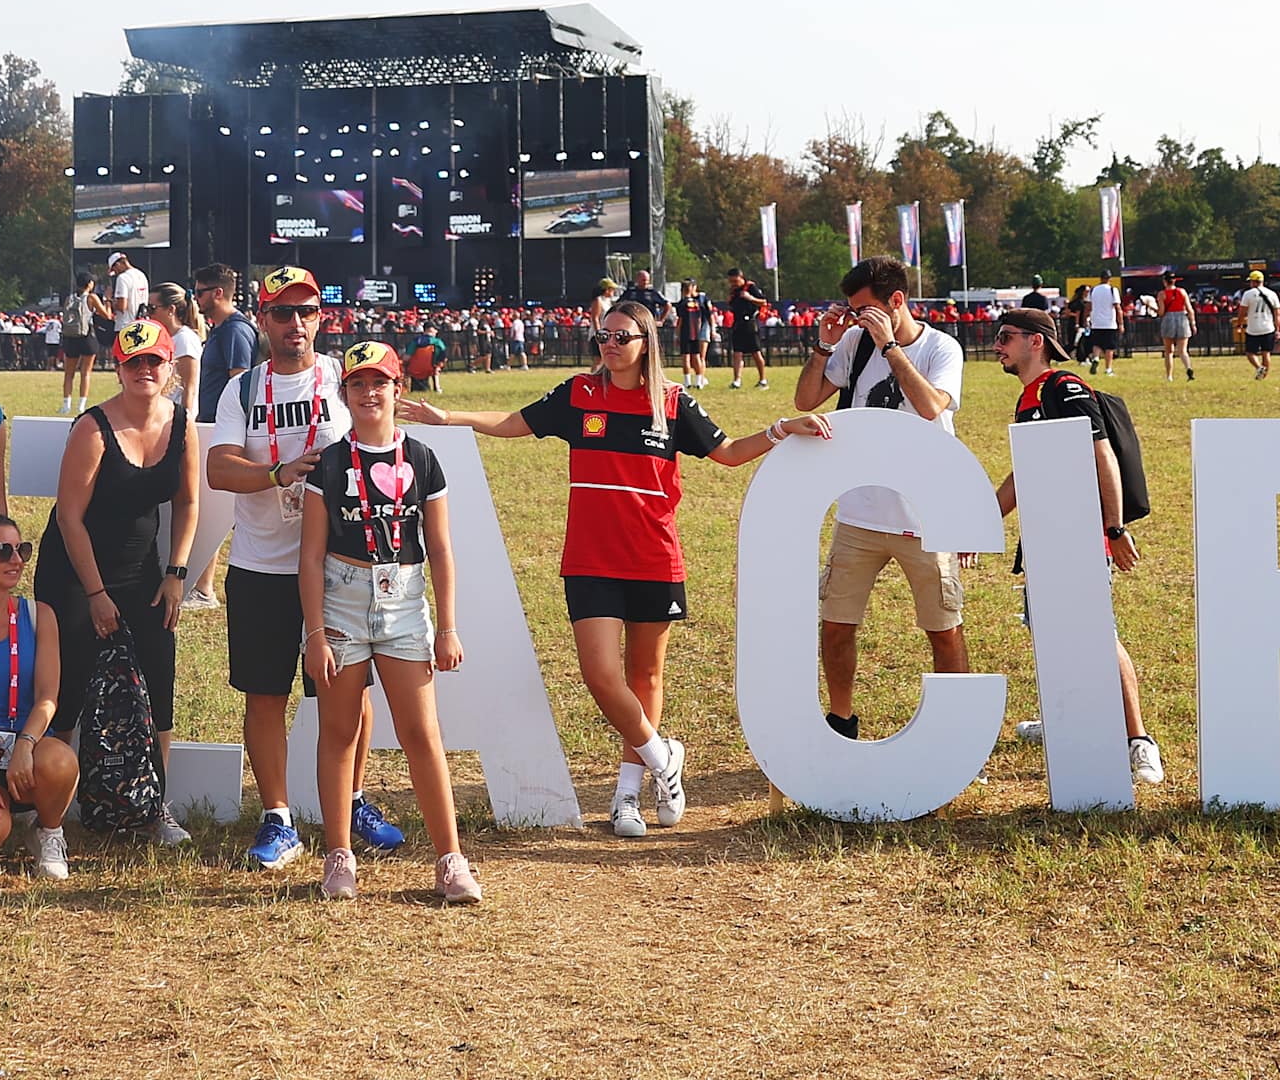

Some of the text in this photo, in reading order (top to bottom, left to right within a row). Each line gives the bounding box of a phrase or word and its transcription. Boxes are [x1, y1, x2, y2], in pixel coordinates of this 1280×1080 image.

[276, 219, 316, 228] SIMON
[449, 215, 481, 224] SIMON
[276, 227, 330, 237] VINCENT
[449, 223, 492, 233] VINCENT
[252, 398, 331, 430] PUMA
